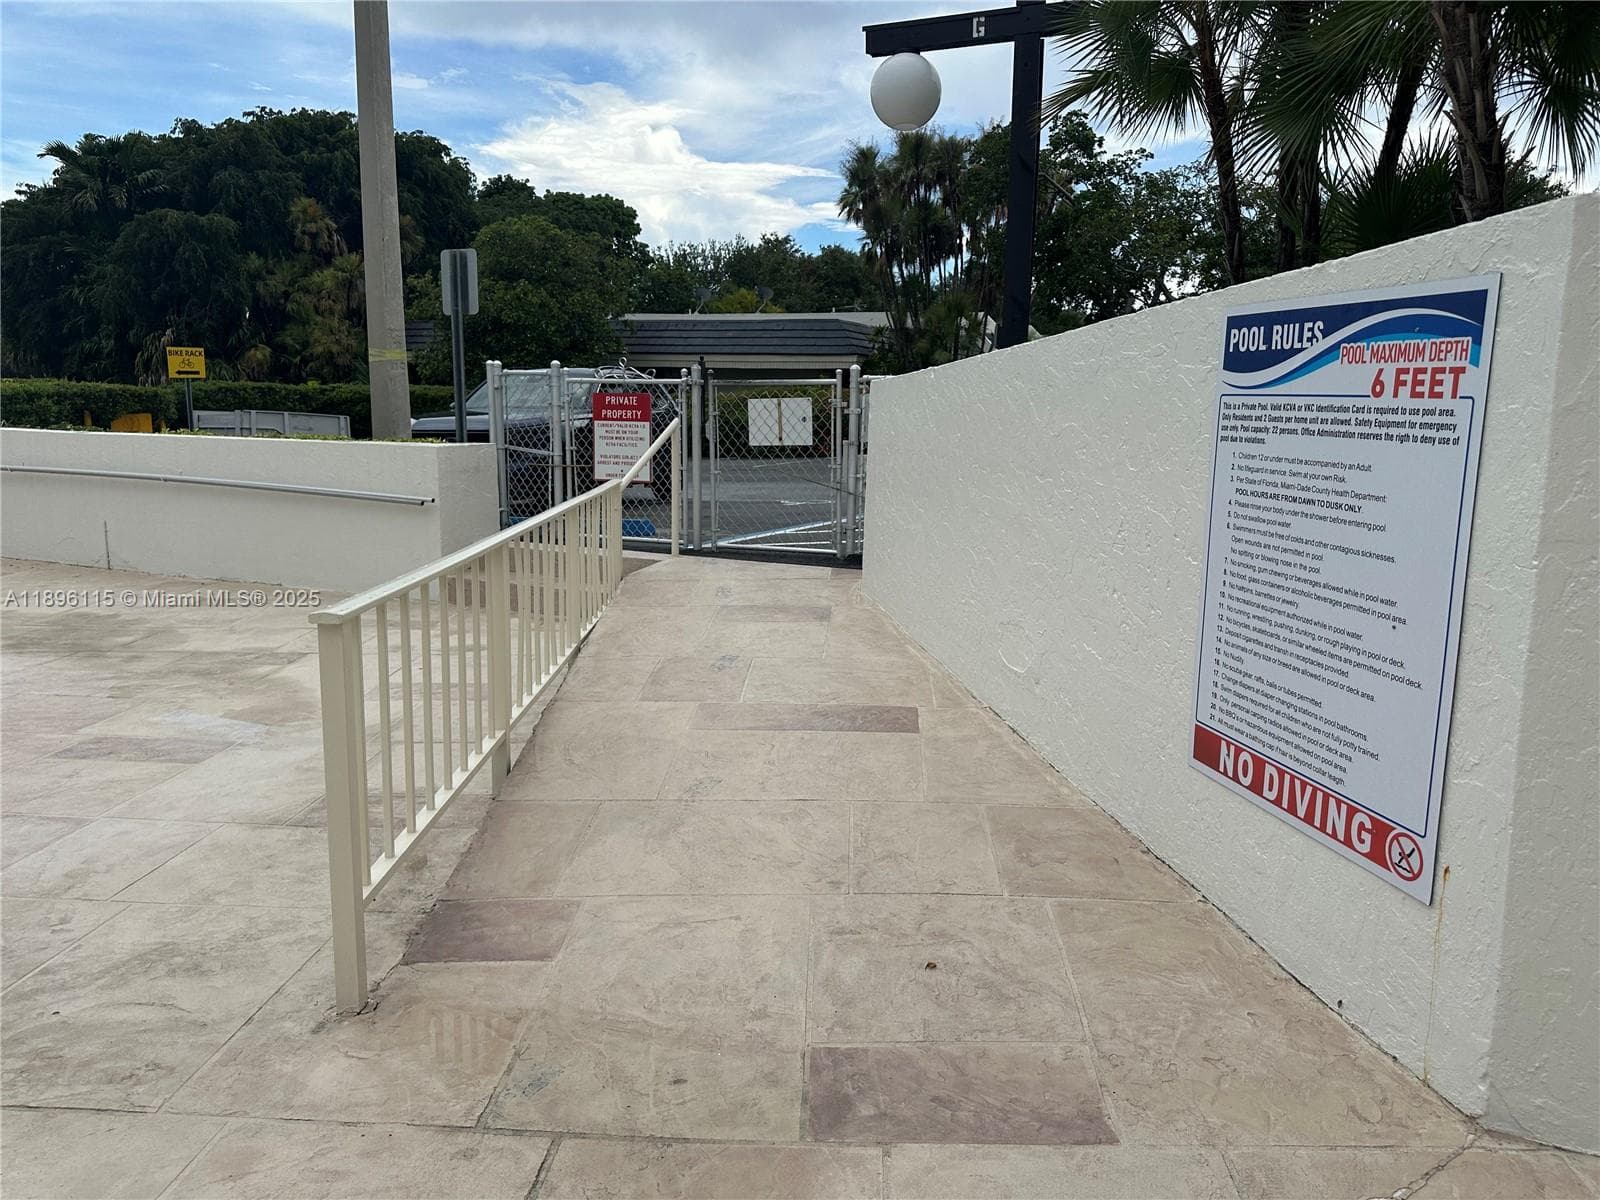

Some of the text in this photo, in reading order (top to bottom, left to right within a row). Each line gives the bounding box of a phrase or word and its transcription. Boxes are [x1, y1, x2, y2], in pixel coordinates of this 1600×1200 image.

[972, 16, 986, 38] G
[1229, 320, 1324, 352] POOL RULES
[1340, 339, 1470, 365] POOL MAXIMUM DEPTH
[1371, 366, 1467, 399] 6 FEET
[605, 396, 638, 406] PRIVATE
[1240, 402, 1257, 410] Private
[1269, 402, 1282, 411] Valid
[1282, 402, 1296, 411] KCVA
[1303, 403, 1315, 412] VKC
[1315, 403, 1350, 413] Identification
[1351, 404, 1365, 414] Card
[1366, 404, 1372, 414] is
[1372, 404, 1399, 417] required
[1399, 405, 1407, 415] to
[1407, 407, 1420, 415] use
[1420, 405, 1437, 418] pool
[1437, 408, 1456, 417] area.
[601, 409, 642, 419] PROPERTY
[1253, 413, 1263, 422] and
[1263, 413, 1267, 422] 2
[1284, 416, 1293, 425] per
[1293, 415, 1308, 424] home
[1308, 415, 1319, 424] unit
[1319, 417, 1328, 425] are
[1329, 416, 1353, 426] allowed.
[1353, 417, 1373, 429] Safety
[1373, 418, 1407, 431] Equipment
[1407, 419, 1418, 429] for
[1417, 421, 1457, 433] emergency
[1239, 423, 1250, 432] Pool
[1271, 425, 1278, 434] 22
[1300, 427, 1316, 436] Office
[1316, 428, 1356, 439] Administration
[1356, 432, 1383, 441] reserves
[1383, 431, 1394, 441] the
[1394, 432, 1410, 444] rigth
[1411, 433, 1419, 443] to
[1418, 433, 1437, 446] deny
[1437, 436, 1451, 445] use
[1451, 435, 1460, 445] of
[1302, 470, 1309, 479] at
[1308, 472, 1320, 482] your
[1303, 457, 1339, 470] accompanied
[1339, 460, 1347, 471] by
[1355, 462, 1373, 472] Adult.
[1235, 487, 1249, 496] POOL
[1249, 489, 1268, 499] HOURS
[1268, 492, 1280, 501] ARE
[1280, 494, 1297, 503] FROM
[1297, 496, 1316, 506] DAWN
[1316, 499, 1325, 508] TO
[1325, 500, 1343, 510] DUSK
[1310, 485, 1350, 498] County Health
[1308, 511, 1372, 531] shower before entering
[1304, 537, 1397, 563] and other contagious sicknesses.
[1305, 550, 1311, 559] in
[1294, 574, 1399, 608] beverages allowed while in pool water.
[1313, 592, 1408, 625] beverages permitted in pool area.
[1327, 623, 1363, 641] in pool water.
[1317, 634, 1406, 669] or rough playing in pool or deck.
[1327, 649, 1424, 689] items are permitted on pool deck.
[1321, 674, 1376, 701] in pool or deck area.
[1318, 713, 1368, 741] in pool bathrooms.
[1301, 732, 1338, 755] in pool or deck
[1312, 725, 1380, 760] are not fully potty trained.
[1292, 753, 1327, 777] beyond collar
[1313, 752, 1333, 768] on pool
[1218, 738, 1373, 854] NO DIVING
